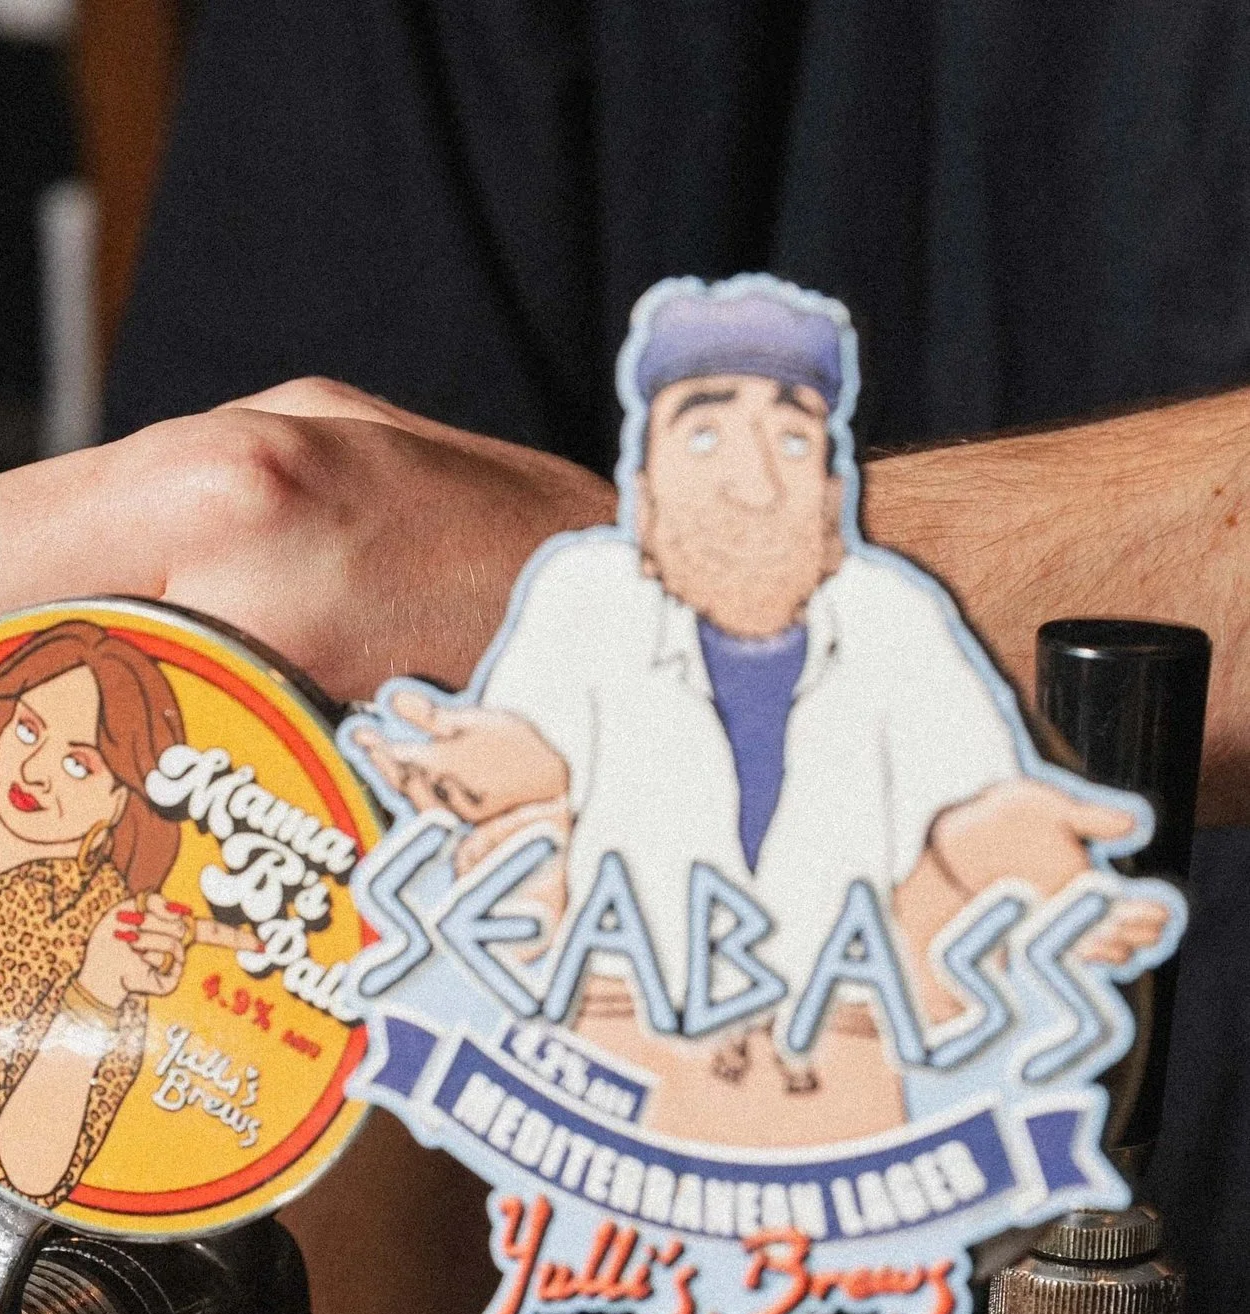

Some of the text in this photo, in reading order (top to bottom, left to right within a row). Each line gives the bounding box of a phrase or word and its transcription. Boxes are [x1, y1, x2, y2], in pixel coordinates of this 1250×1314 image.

[145, 744, 358, 874] Mama
[200, 832, 330, 922] B's
[202, 973, 274, 1031] 4.9%
[359, 823, 1109, 1083] SEABASS
[152, 1068, 262, 1148] Brews
[452, 1071, 989, 1241] MEDITERRANEAN LAGER
